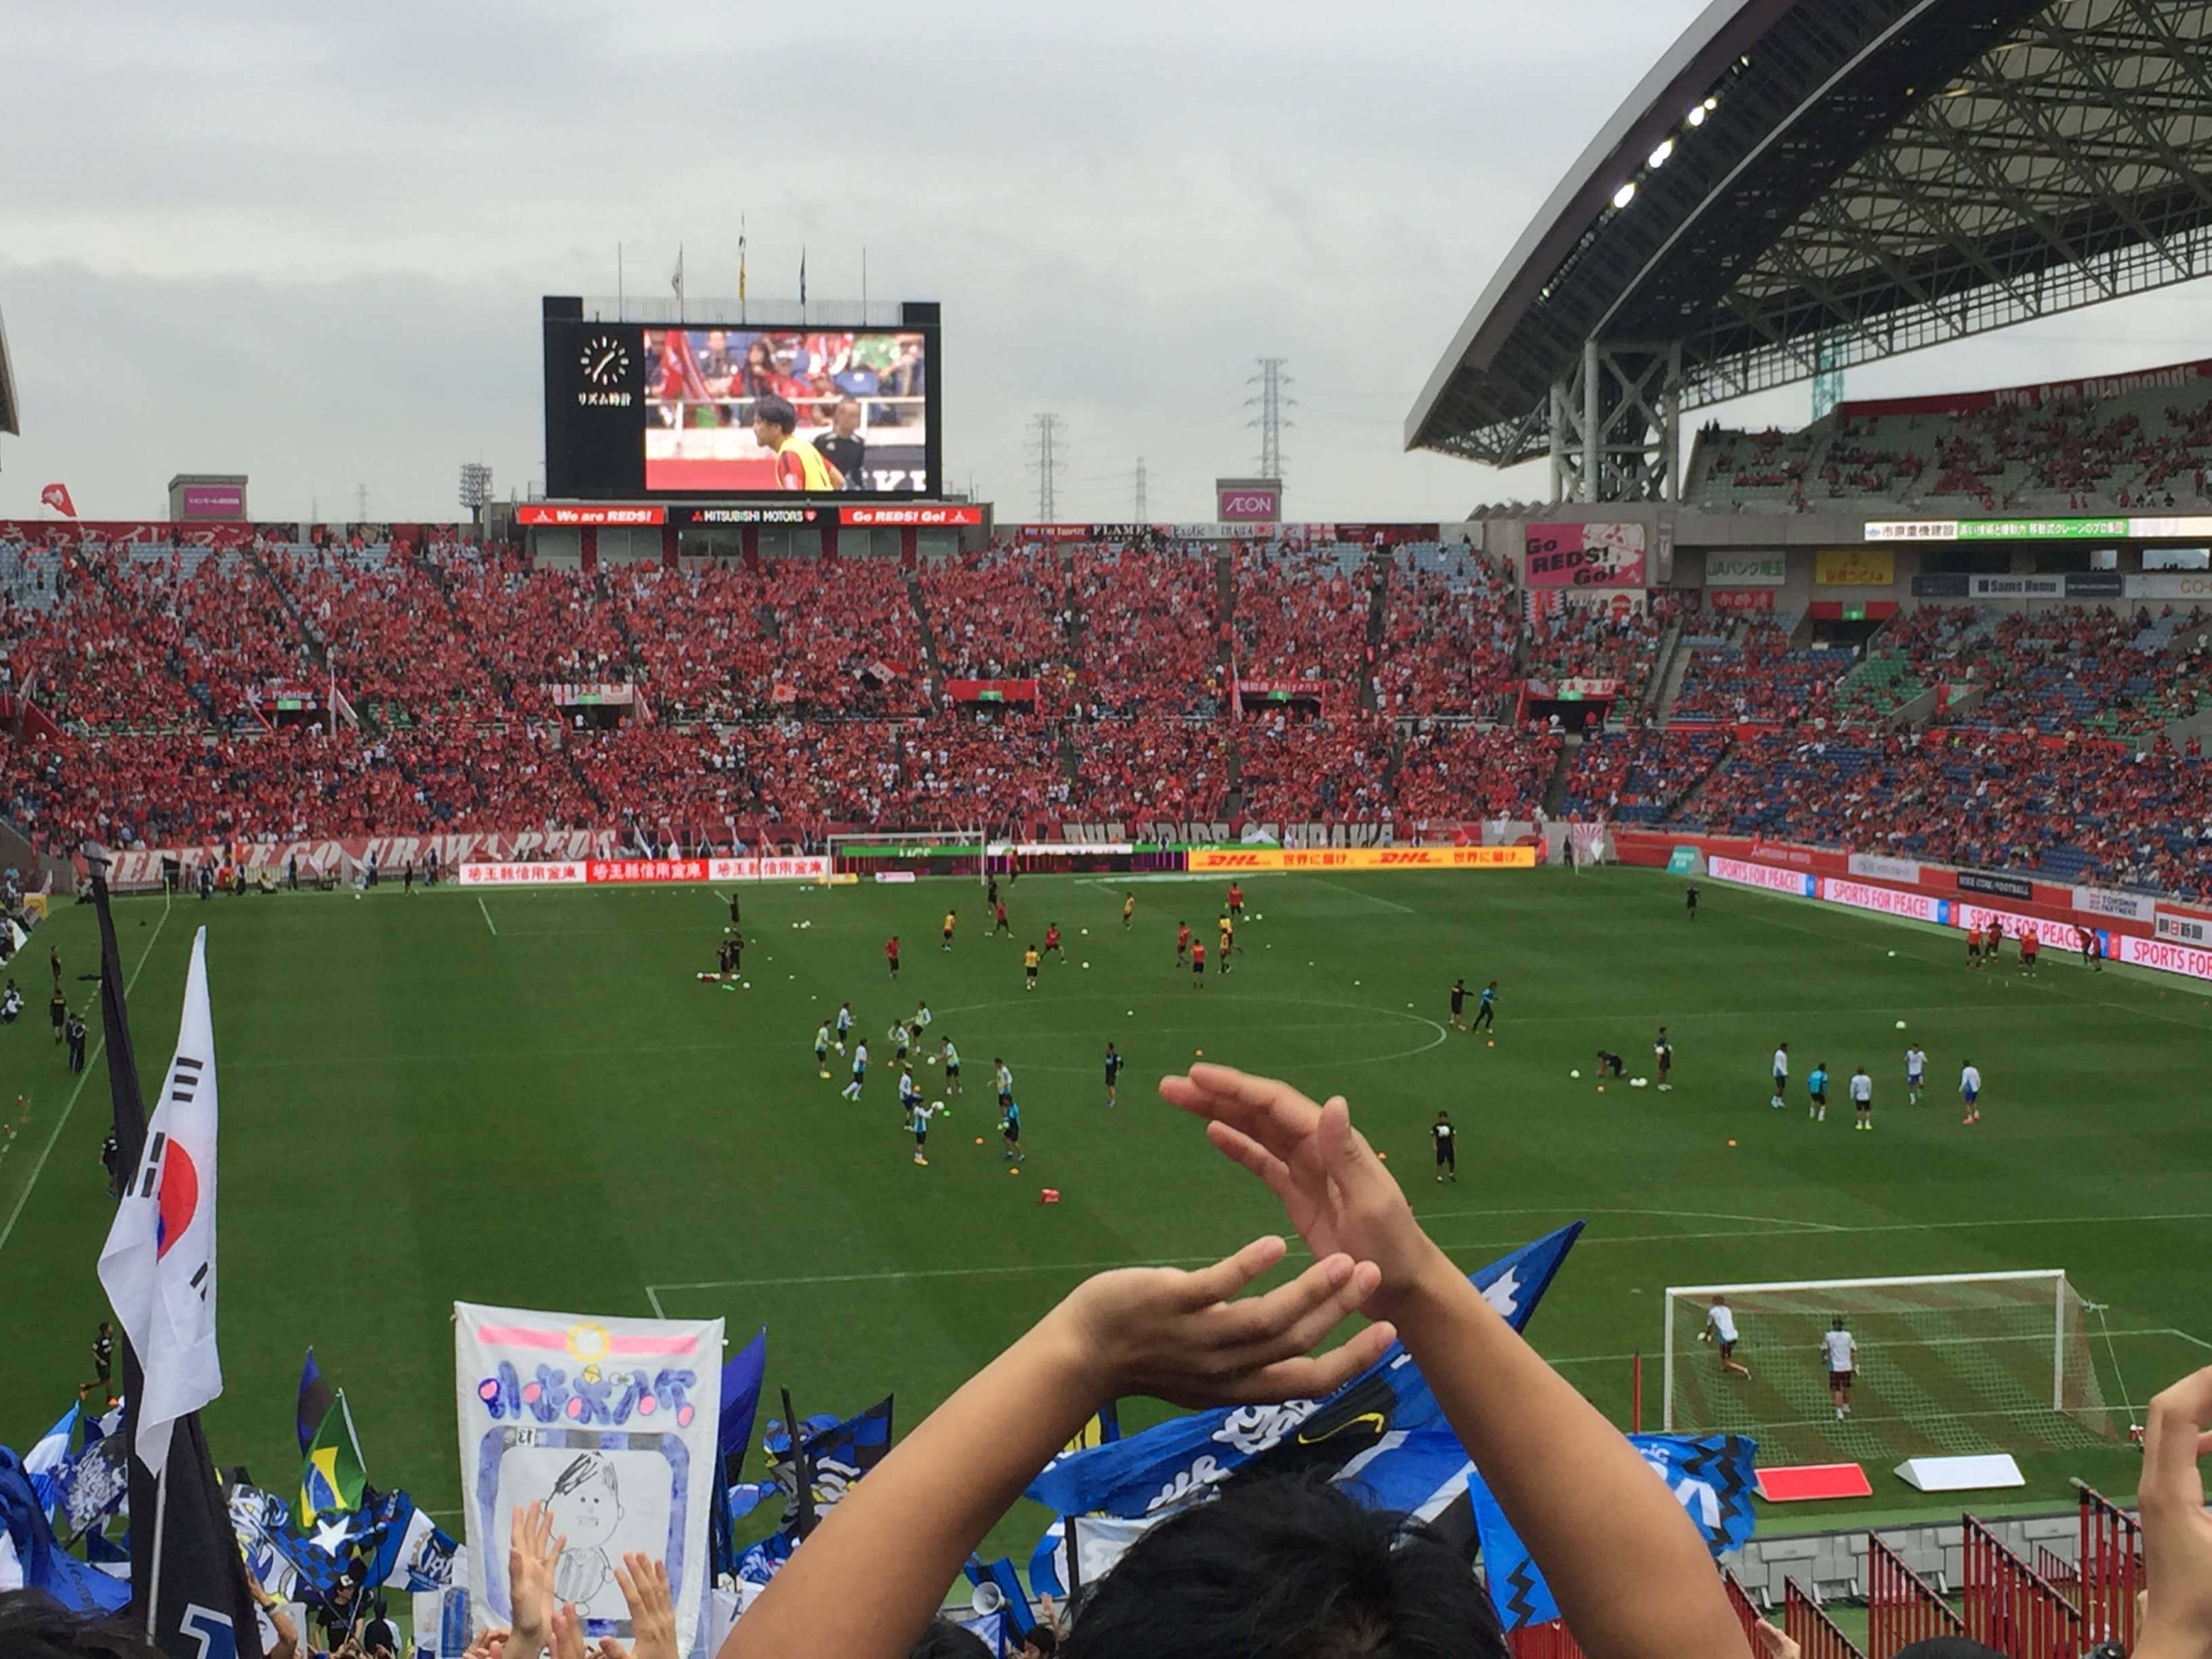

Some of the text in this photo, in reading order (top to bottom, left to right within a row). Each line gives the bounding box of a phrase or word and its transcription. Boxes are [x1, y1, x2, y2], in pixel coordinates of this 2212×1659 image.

[2082, 366, 2198, 400] Diamonds
[556, 510, 653, 522] We are REDS!
[703, 510, 804, 523] MITSUBISHI MOTORS
[852, 510, 946, 523] Go REDS! Go!
[1526, 537, 1557, 555] Go
[1532, 545, 1610, 575] REDS!
[1573, 564, 1616, 585] Go!
[1207, 854, 1261, 866] DHL
[1379, 852, 1432, 863] DHL
[1716, 858, 1748, 881] SPORTS
[1748, 865, 1767, 884] FOR
[1767, 869, 1798, 890] PEACE!
[1833, 882, 1929, 916] SPORTS FOR PEACE!
[2133, 939, 2186, 971] SPORTS
